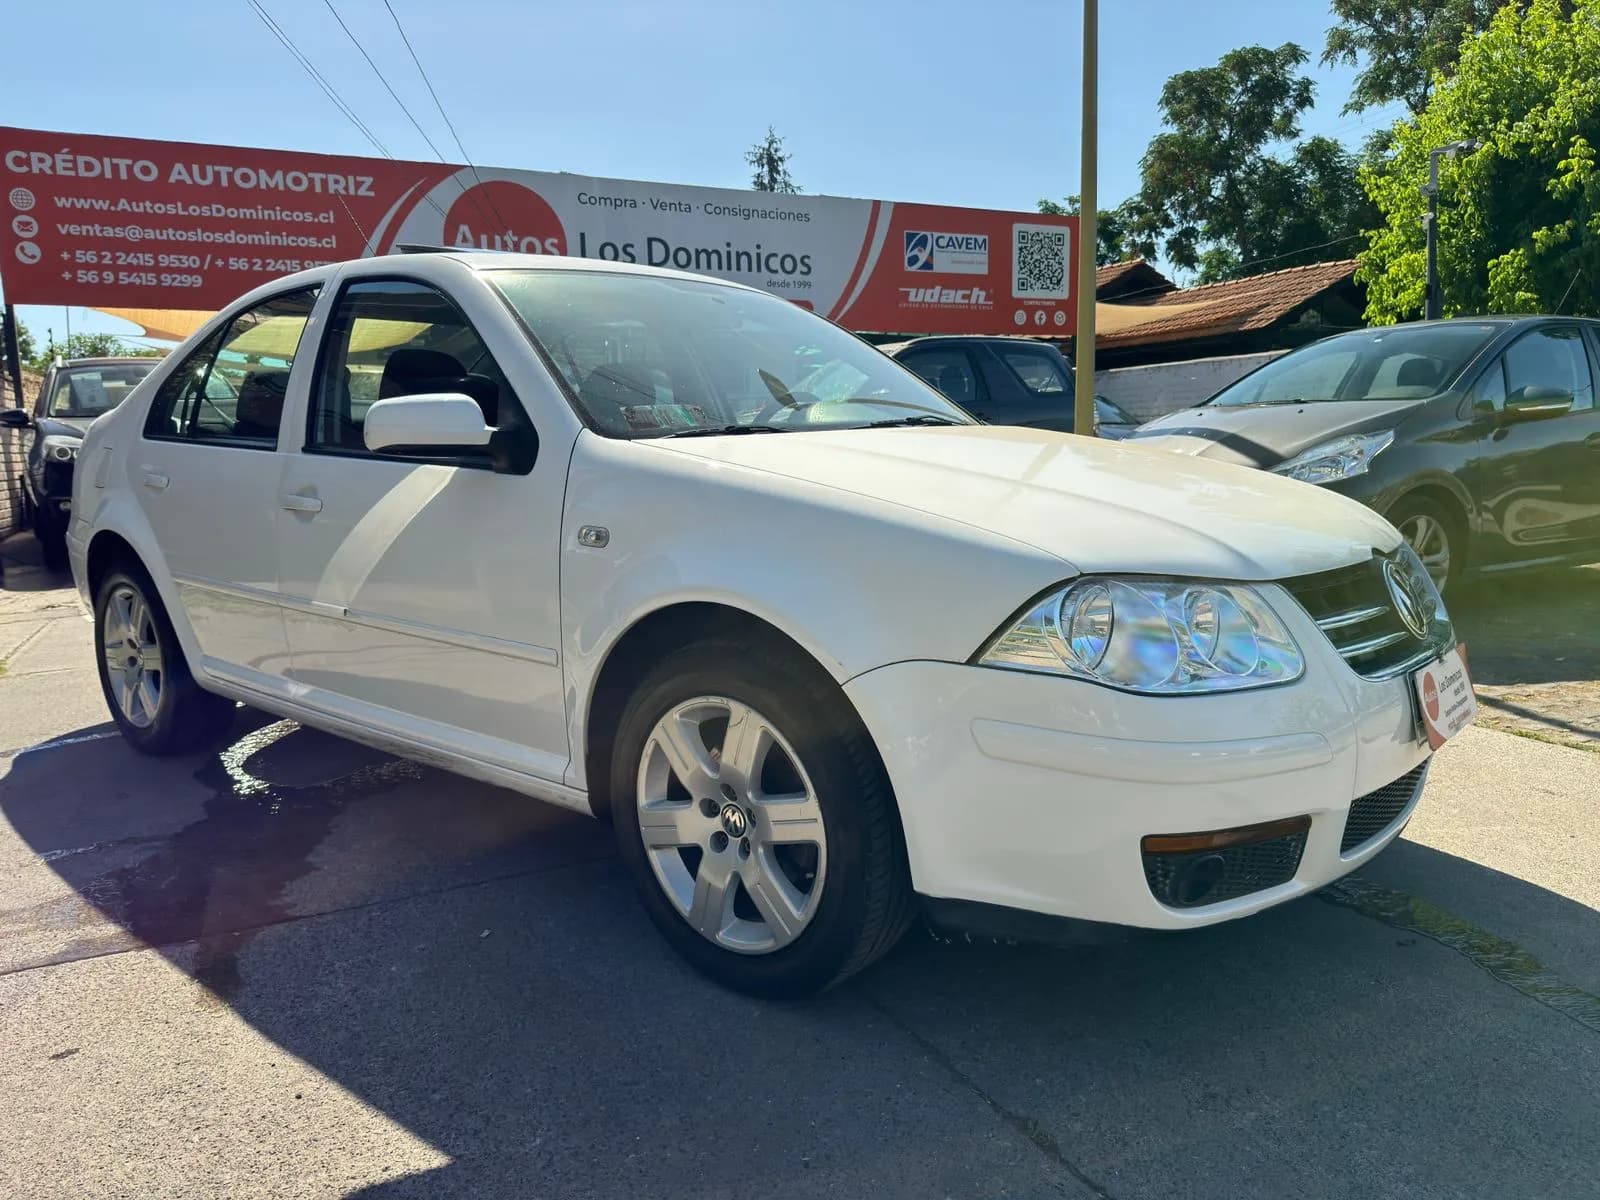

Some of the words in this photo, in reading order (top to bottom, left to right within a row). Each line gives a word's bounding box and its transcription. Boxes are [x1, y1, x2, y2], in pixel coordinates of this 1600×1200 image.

[5, 148, 159, 182] CRÉDITO
[168, 163, 376, 197] AUTOMOTRIZ
[54, 196, 335, 223] www.AutosLosDominicos.cl
[577, 192, 638, 210] Compra
[650, 198, 692, 213] Venta
[704, 202, 811, 223] Consignaciones
[56, 223, 337, 248] ventas@autoslosdominicos.cl
[455, 224, 560, 256] Autos
[935, 235, 987, 251] CAVEM
[75, 249, 98, 264] 56
[101, 251, 113, 264] 2
[115, 251, 155, 267] 2415
[158, 254, 201, 268] 9530
[228, 257, 249, 271] 56
[252, 258, 263, 271] 2
[266, 259, 302, 273] 2415
[579, 231, 637, 265] Los
[646, 236, 812, 276] Dominicos
[77, 270, 100, 284] 56
[102, 271, 115, 284] 9
[118, 271, 158, 286] 5415
[161, 273, 203, 288] 9299
[766, 279, 791, 288] desde
[793, 280, 812, 289] 1999
[899, 286, 994, 305] udach
